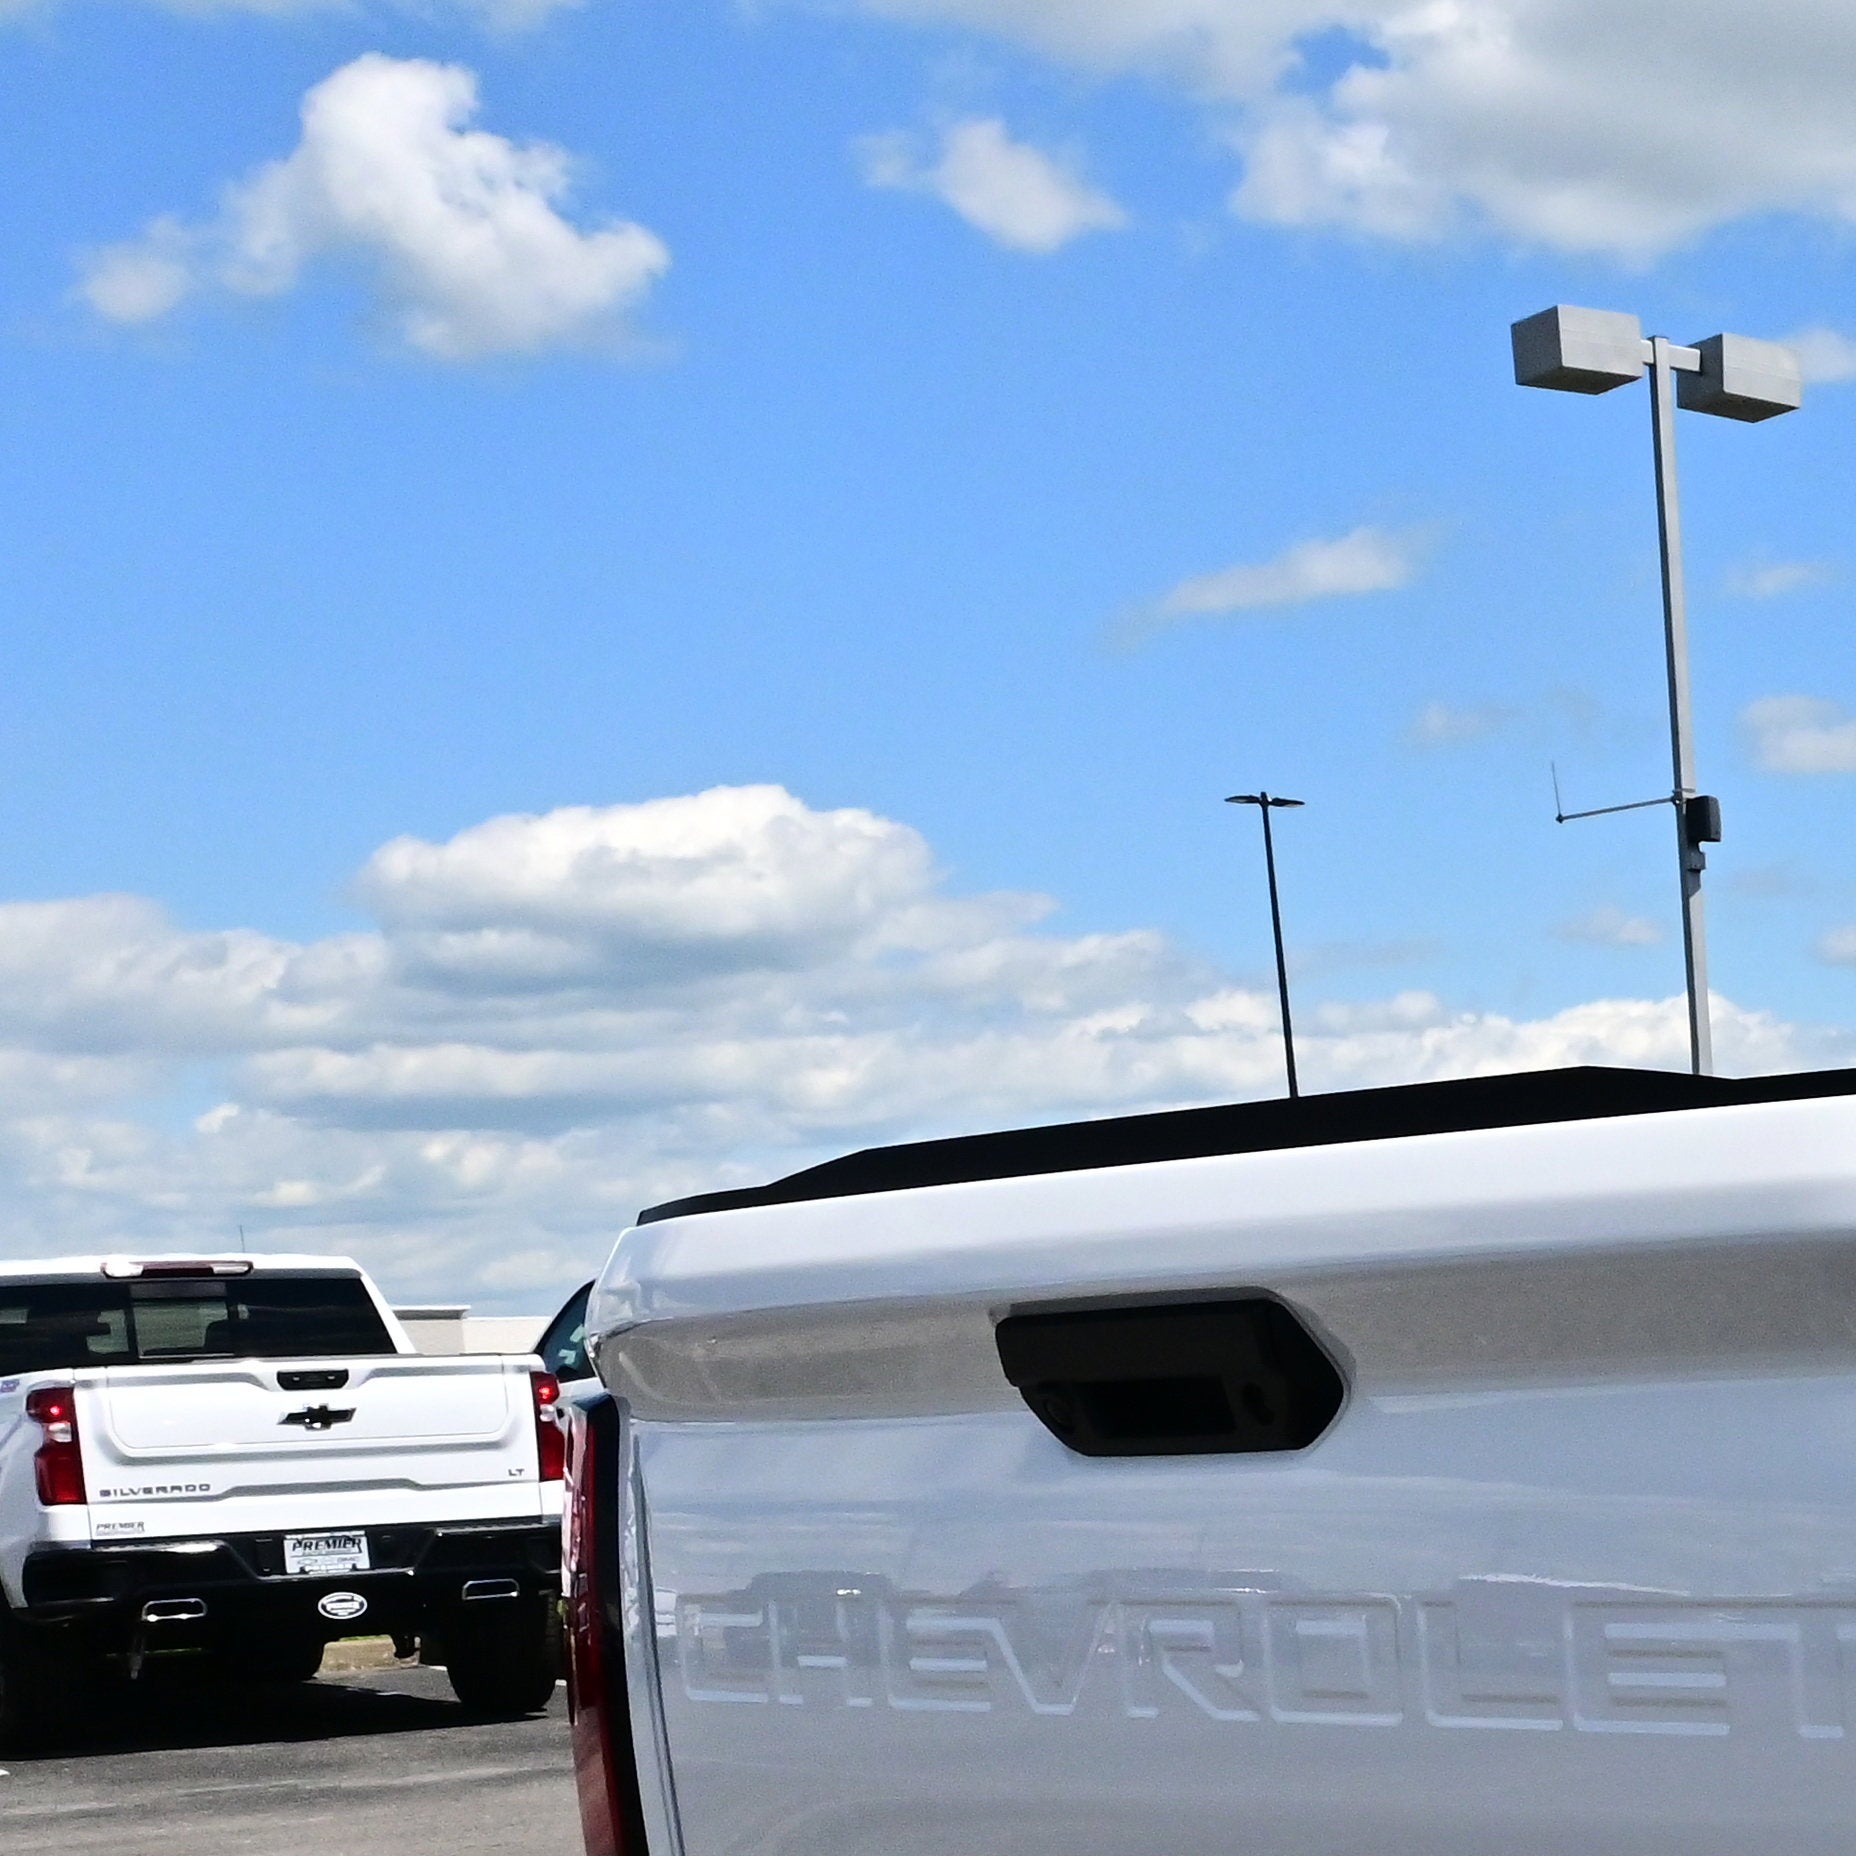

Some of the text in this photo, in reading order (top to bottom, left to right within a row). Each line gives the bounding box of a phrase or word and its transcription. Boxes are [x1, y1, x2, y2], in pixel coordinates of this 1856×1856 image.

[508, 1468, 525, 1477] LT
[99, 1483, 211, 1498] SILVERADO
[292, 1536, 362, 1553] PREMIER
